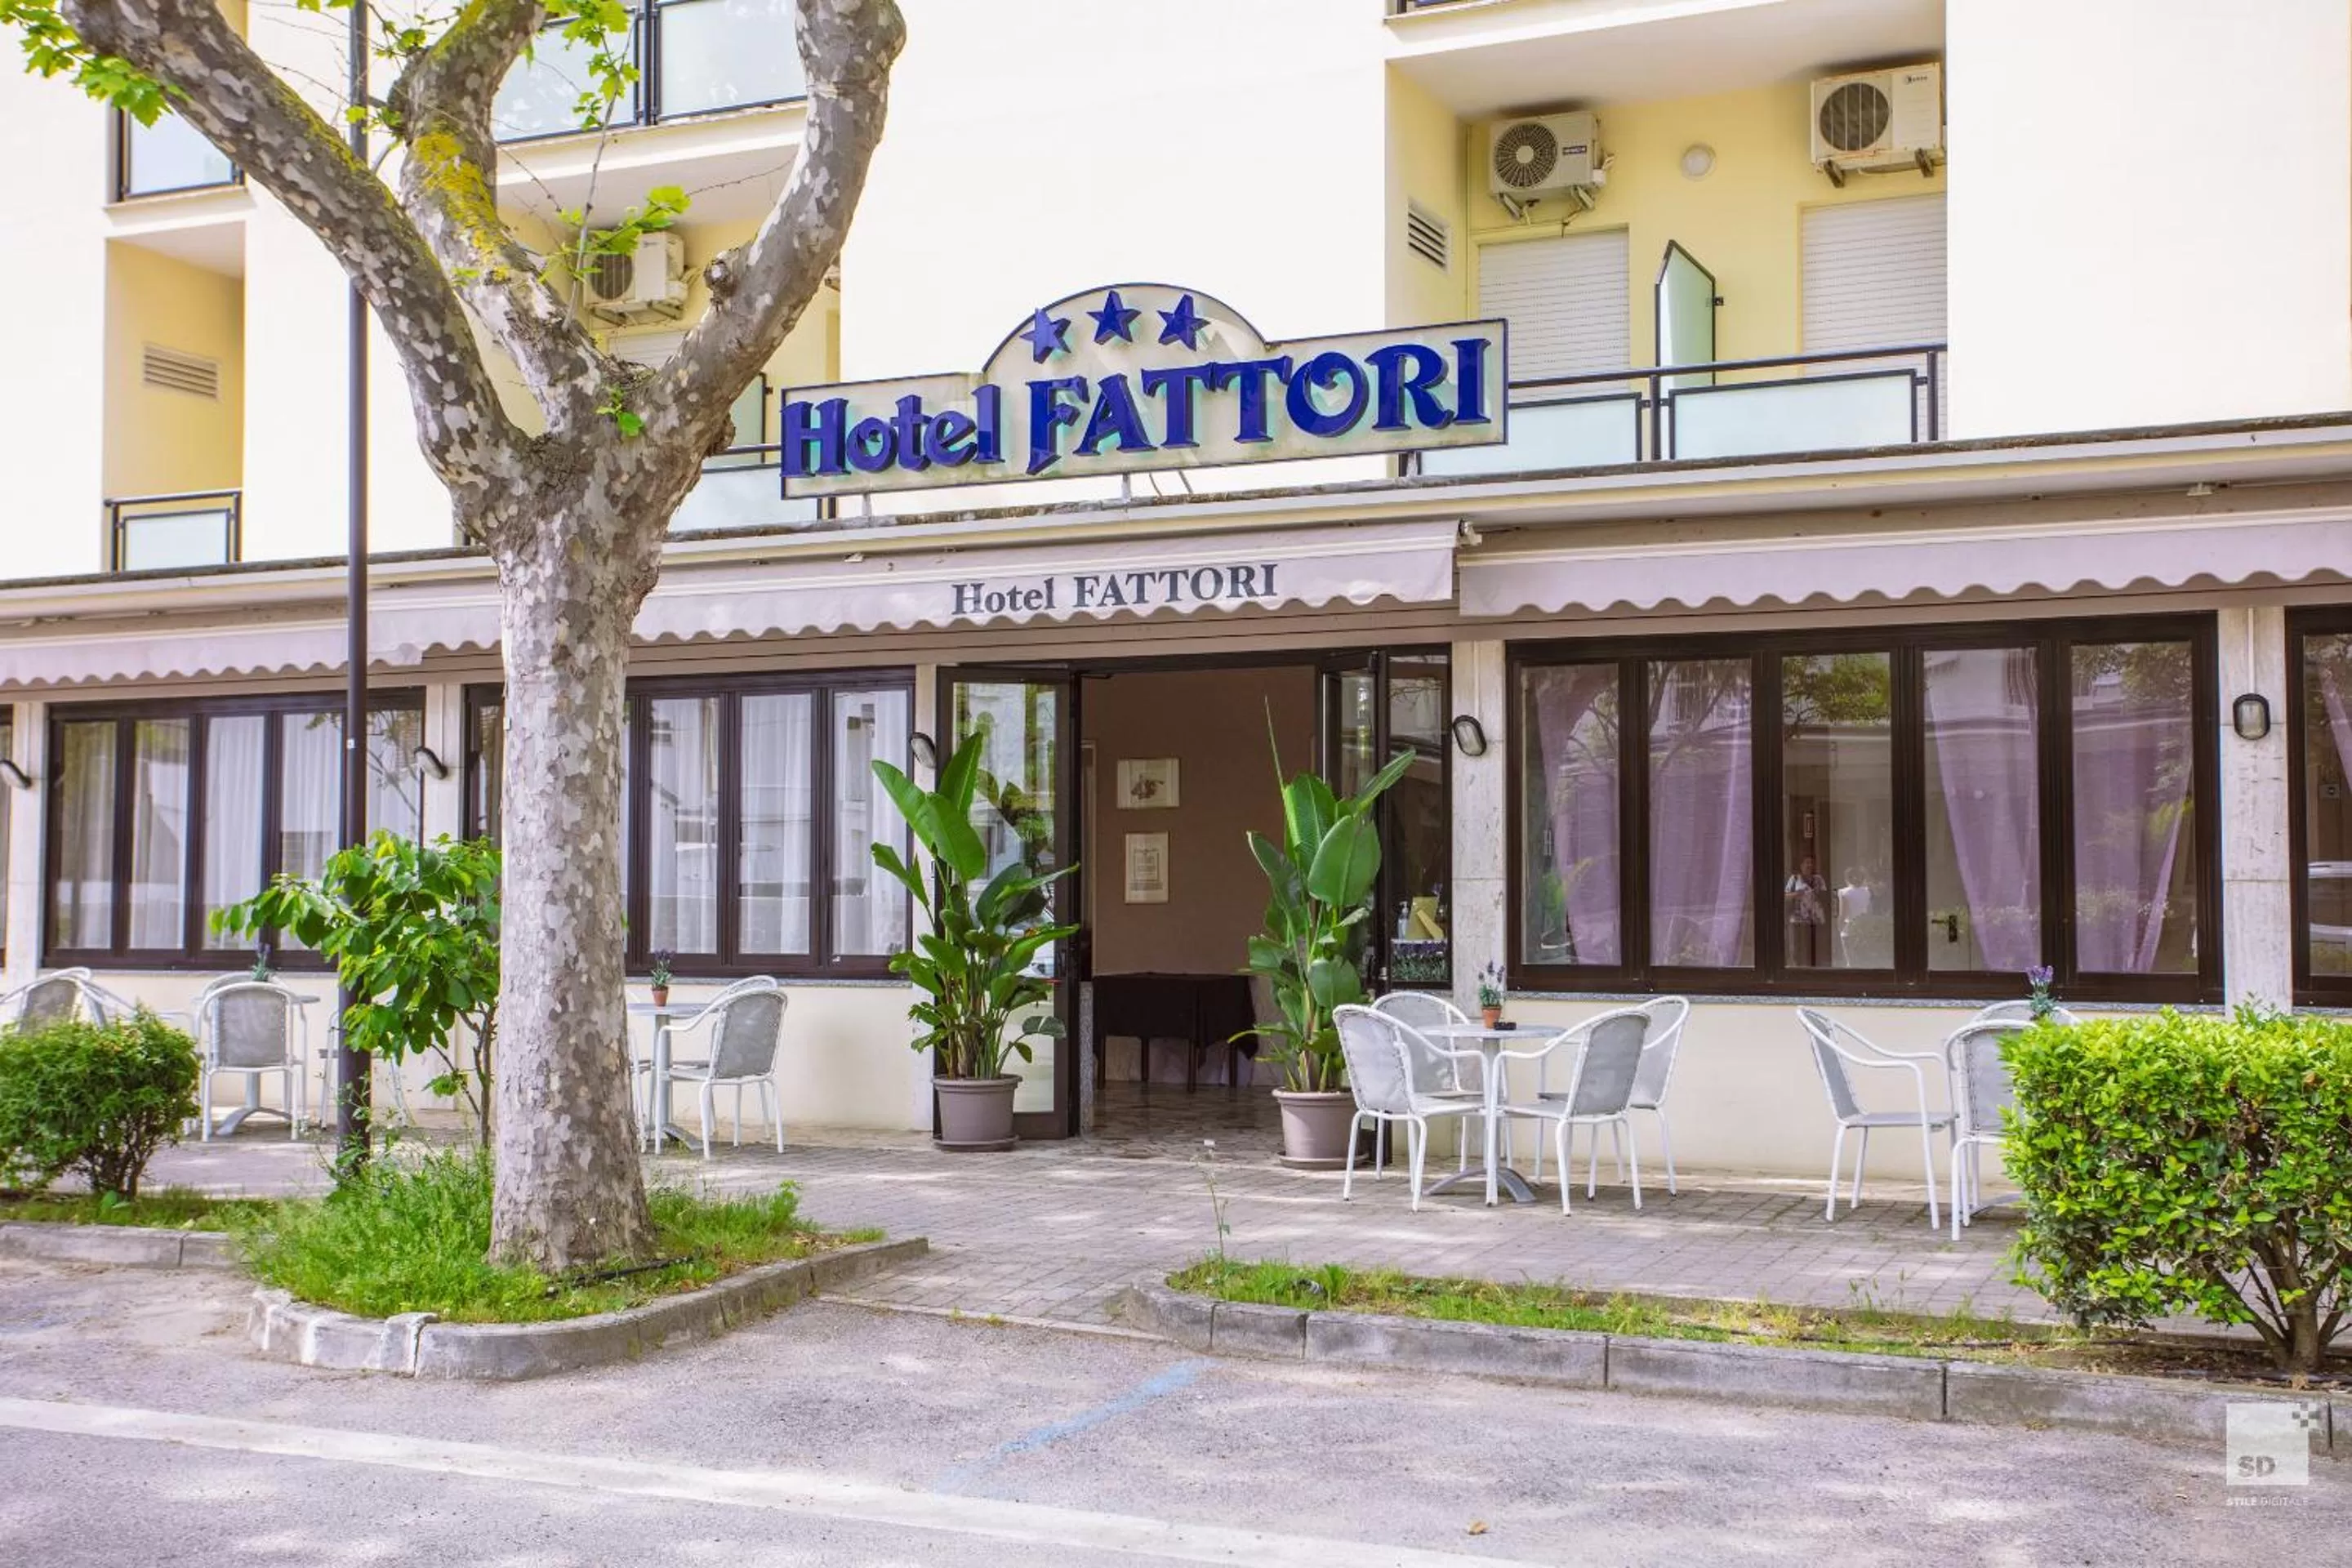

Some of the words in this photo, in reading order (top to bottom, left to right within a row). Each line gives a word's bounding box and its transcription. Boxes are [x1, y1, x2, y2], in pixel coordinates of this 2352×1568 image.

[781, 385, 1005, 477] Hotel
[1026, 339, 1492, 474] FATTORI
[952, 577, 1056, 615] Hotel
[1074, 564, 1278, 608] FATTORI
